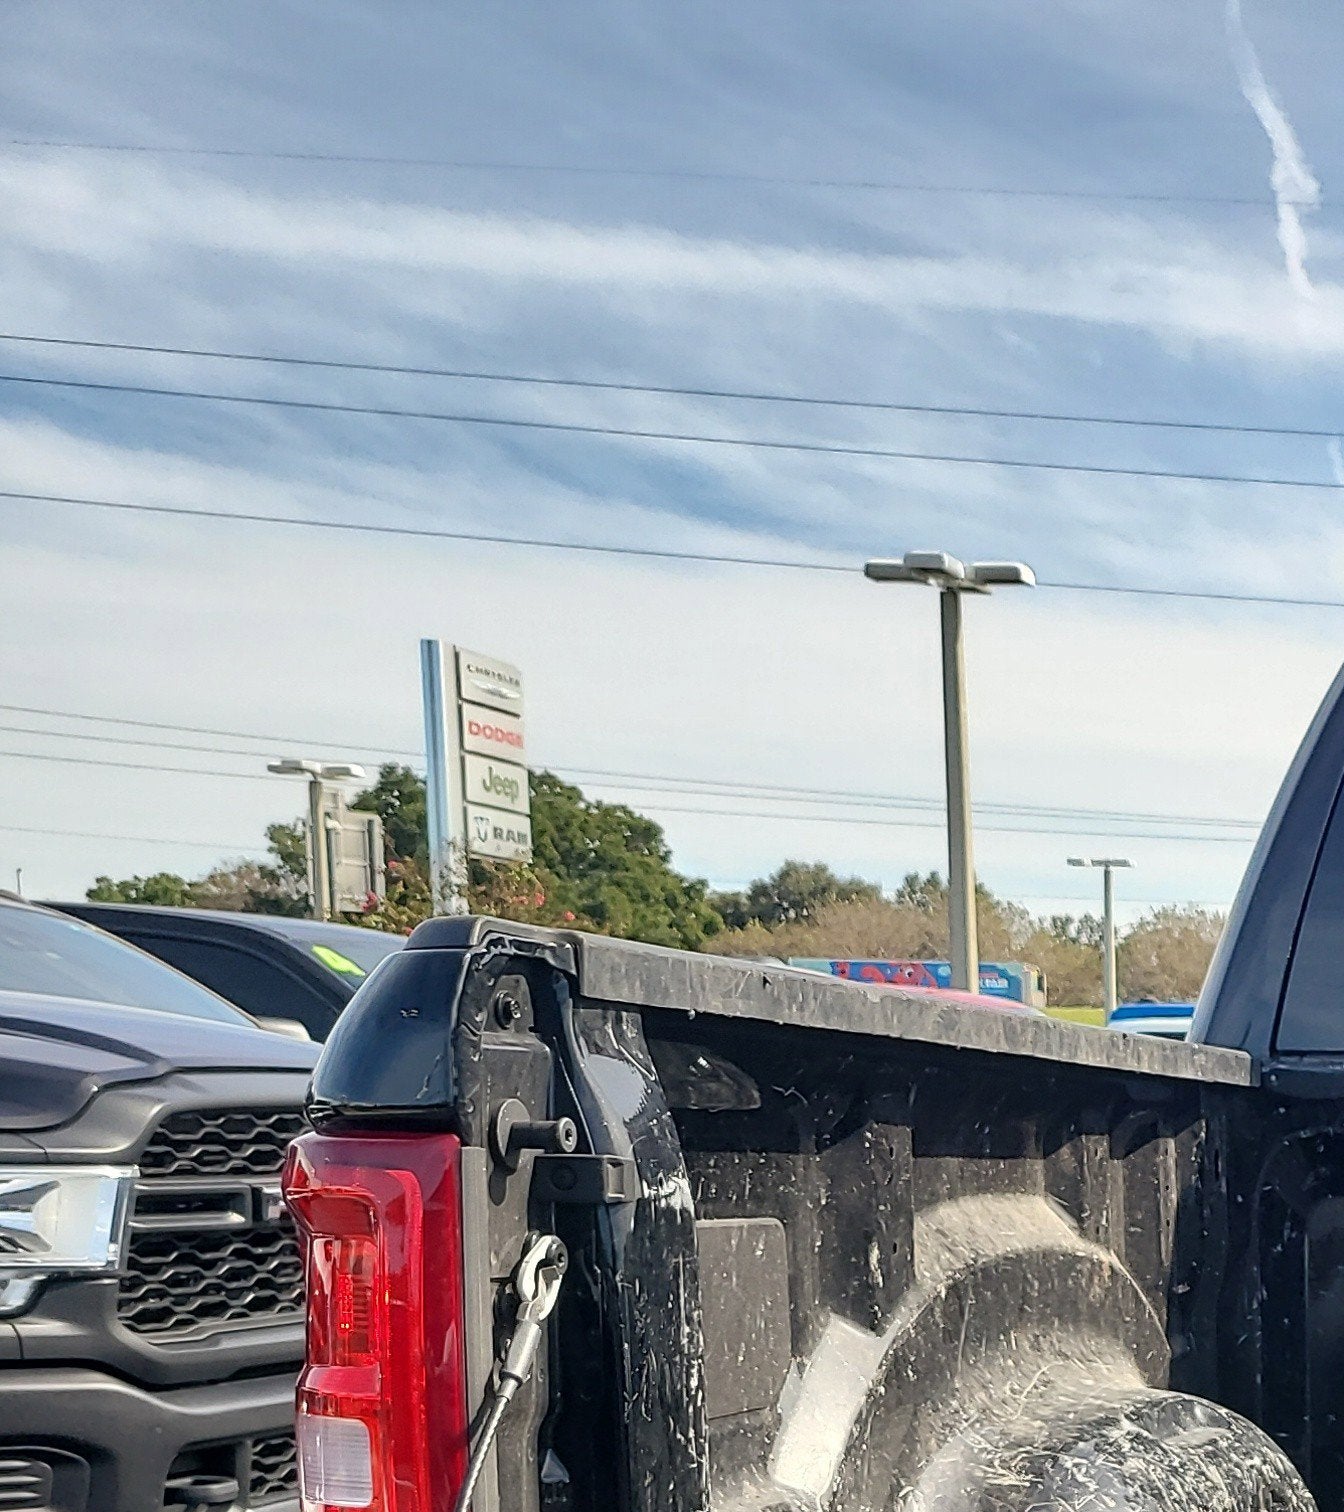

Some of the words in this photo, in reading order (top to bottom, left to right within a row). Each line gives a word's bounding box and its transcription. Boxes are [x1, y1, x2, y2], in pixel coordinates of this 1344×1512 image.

[468, 721, 523, 748] DODGE
[483, 766, 519, 804] Jeep
[494, 826, 528, 844] RAM
